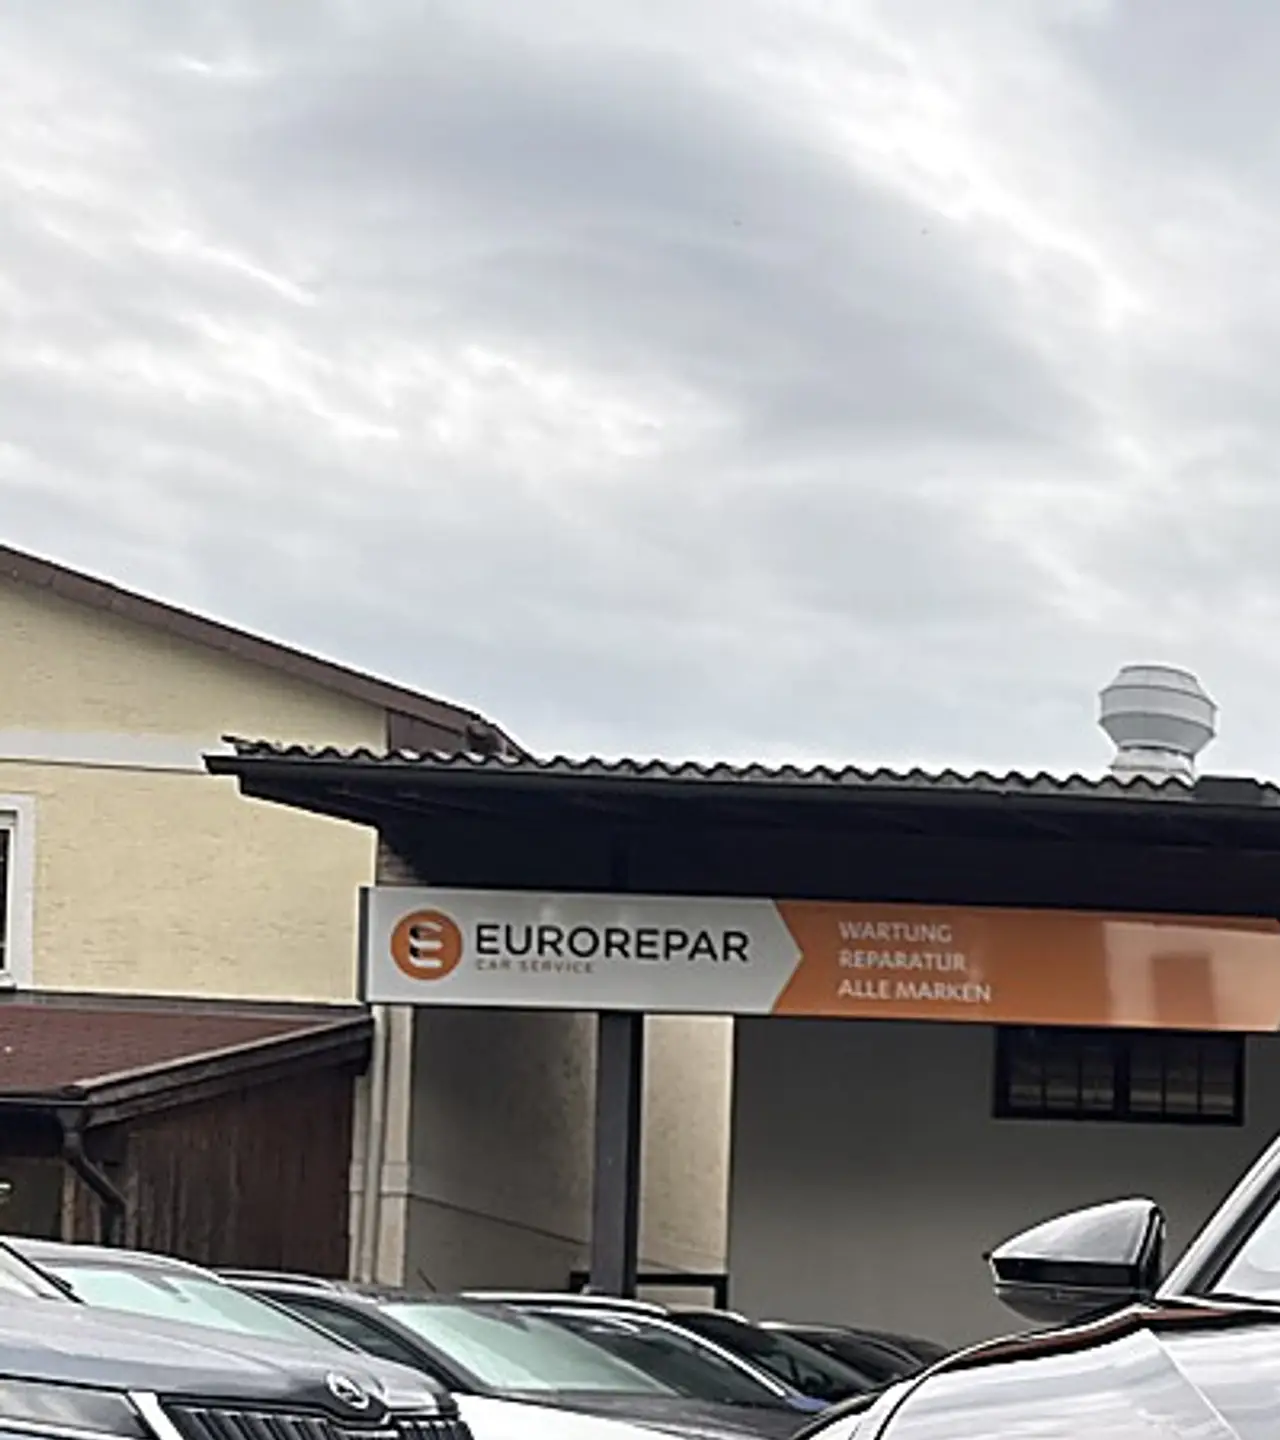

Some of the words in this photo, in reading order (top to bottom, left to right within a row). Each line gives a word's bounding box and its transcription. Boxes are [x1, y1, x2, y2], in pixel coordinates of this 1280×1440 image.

[475, 923, 750, 962] EUROREPAR
[837, 920, 953, 943] WARTUNG
[475, 960, 512, 972] CAR
[518, 961, 595, 974] SERVICE
[837, 948, 968, 972] REPARATUR
[836, 978, 892, 1000] ALLE
[895, 982, 993, 1004] MARKEN
